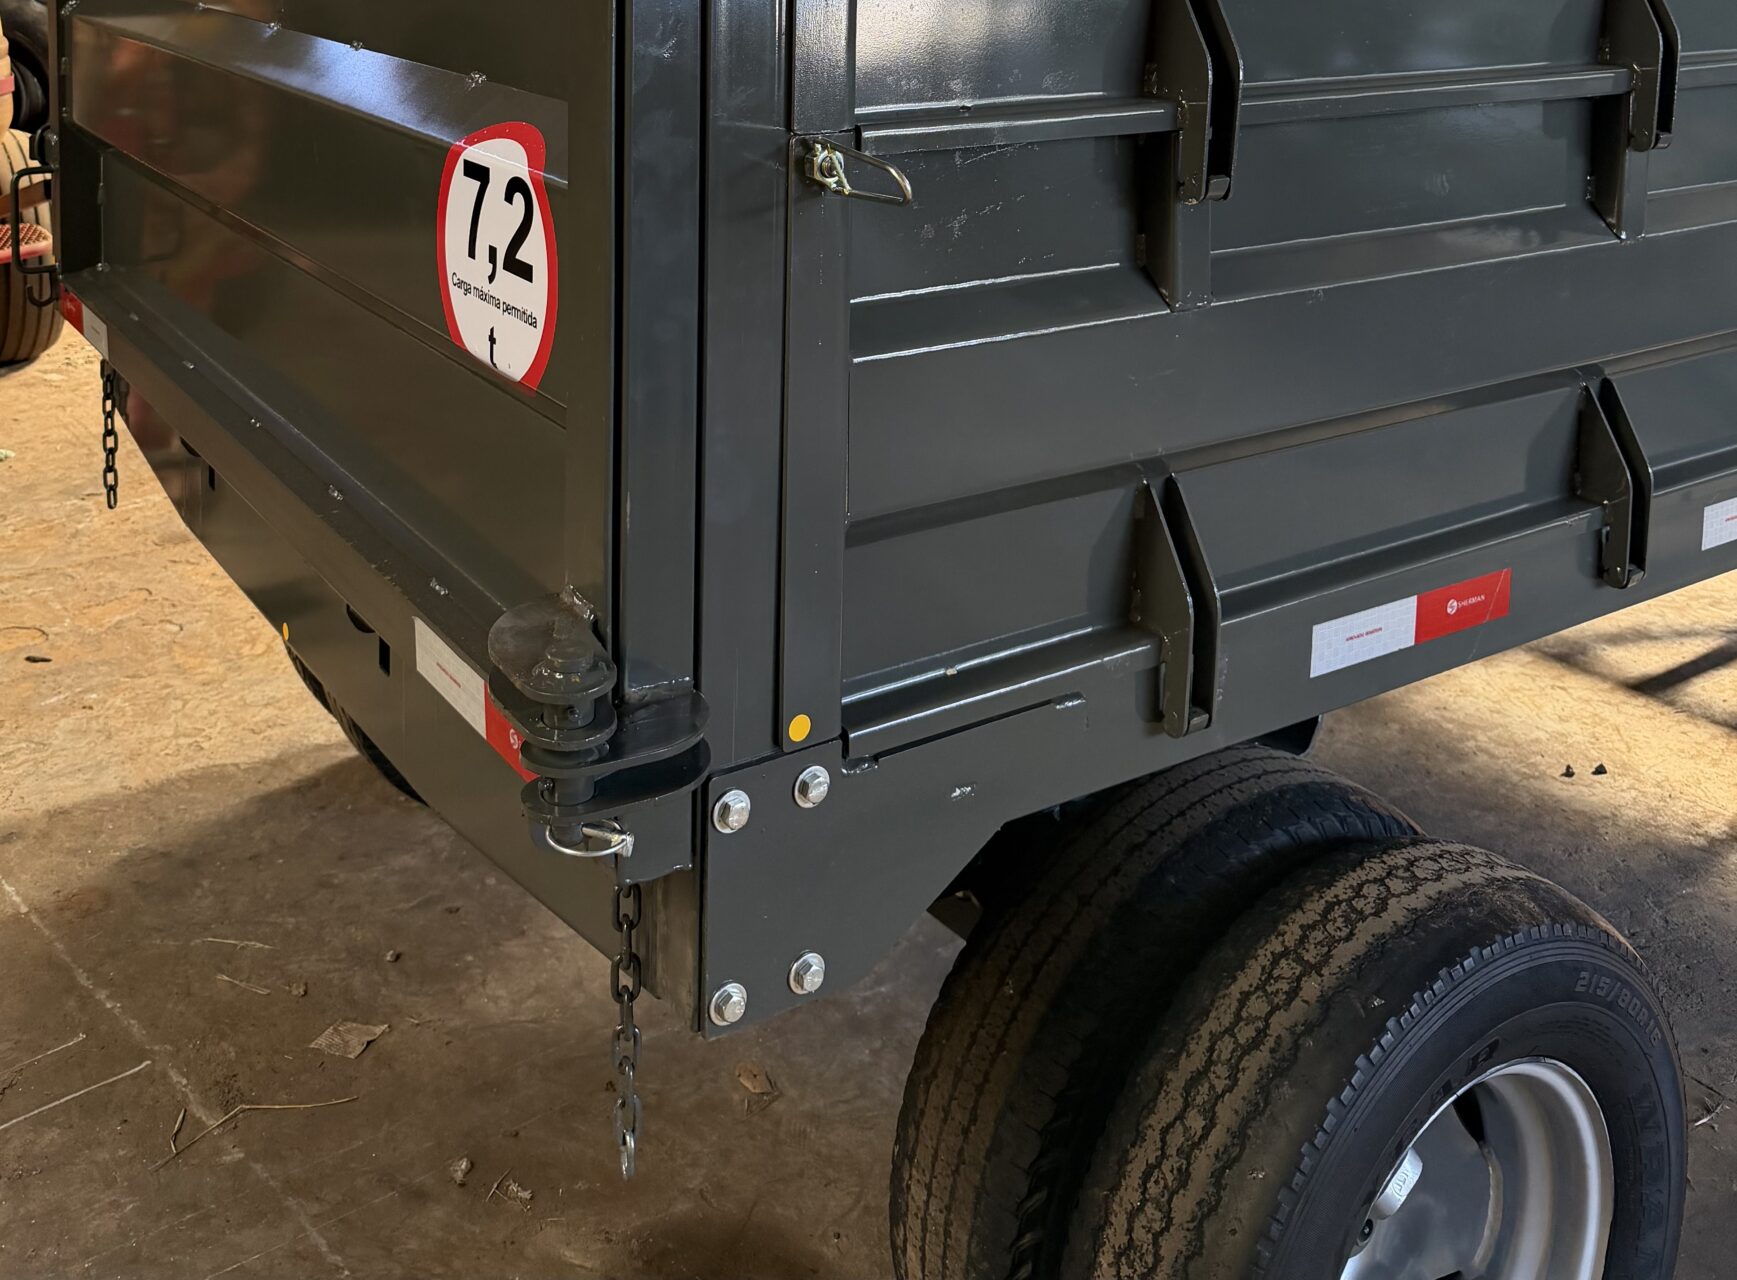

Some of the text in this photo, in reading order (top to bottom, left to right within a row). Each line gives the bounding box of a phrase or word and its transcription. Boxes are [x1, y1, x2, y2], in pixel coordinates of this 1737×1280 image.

[463, 158, 534, 285] 7,2
[451, 271, 537, 329] Carga máxima permitida
[488, 325, 498, 370] t
